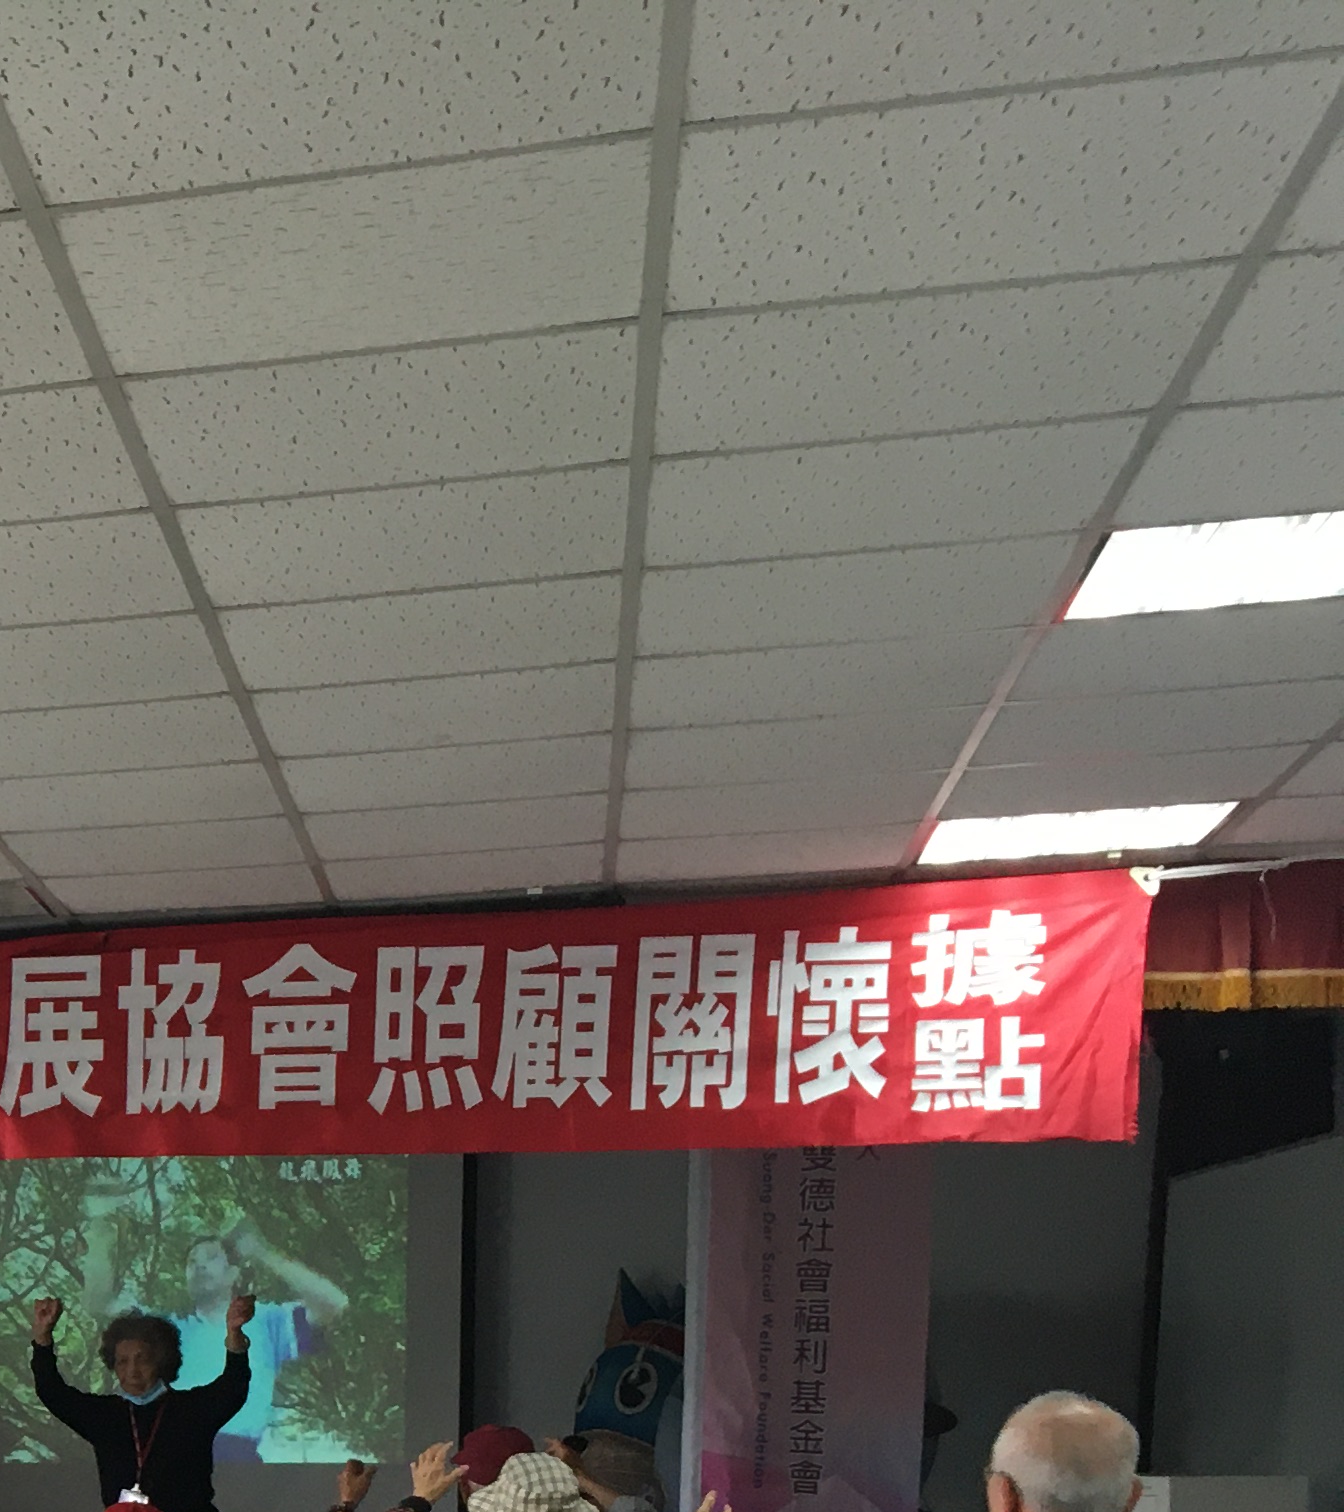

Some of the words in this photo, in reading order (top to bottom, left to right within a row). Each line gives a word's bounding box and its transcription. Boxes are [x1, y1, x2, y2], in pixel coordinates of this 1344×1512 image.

[910, 909, 1048, 1112] 據點
[788, 1144, 837, 1495] 雙德社會福利基金會
